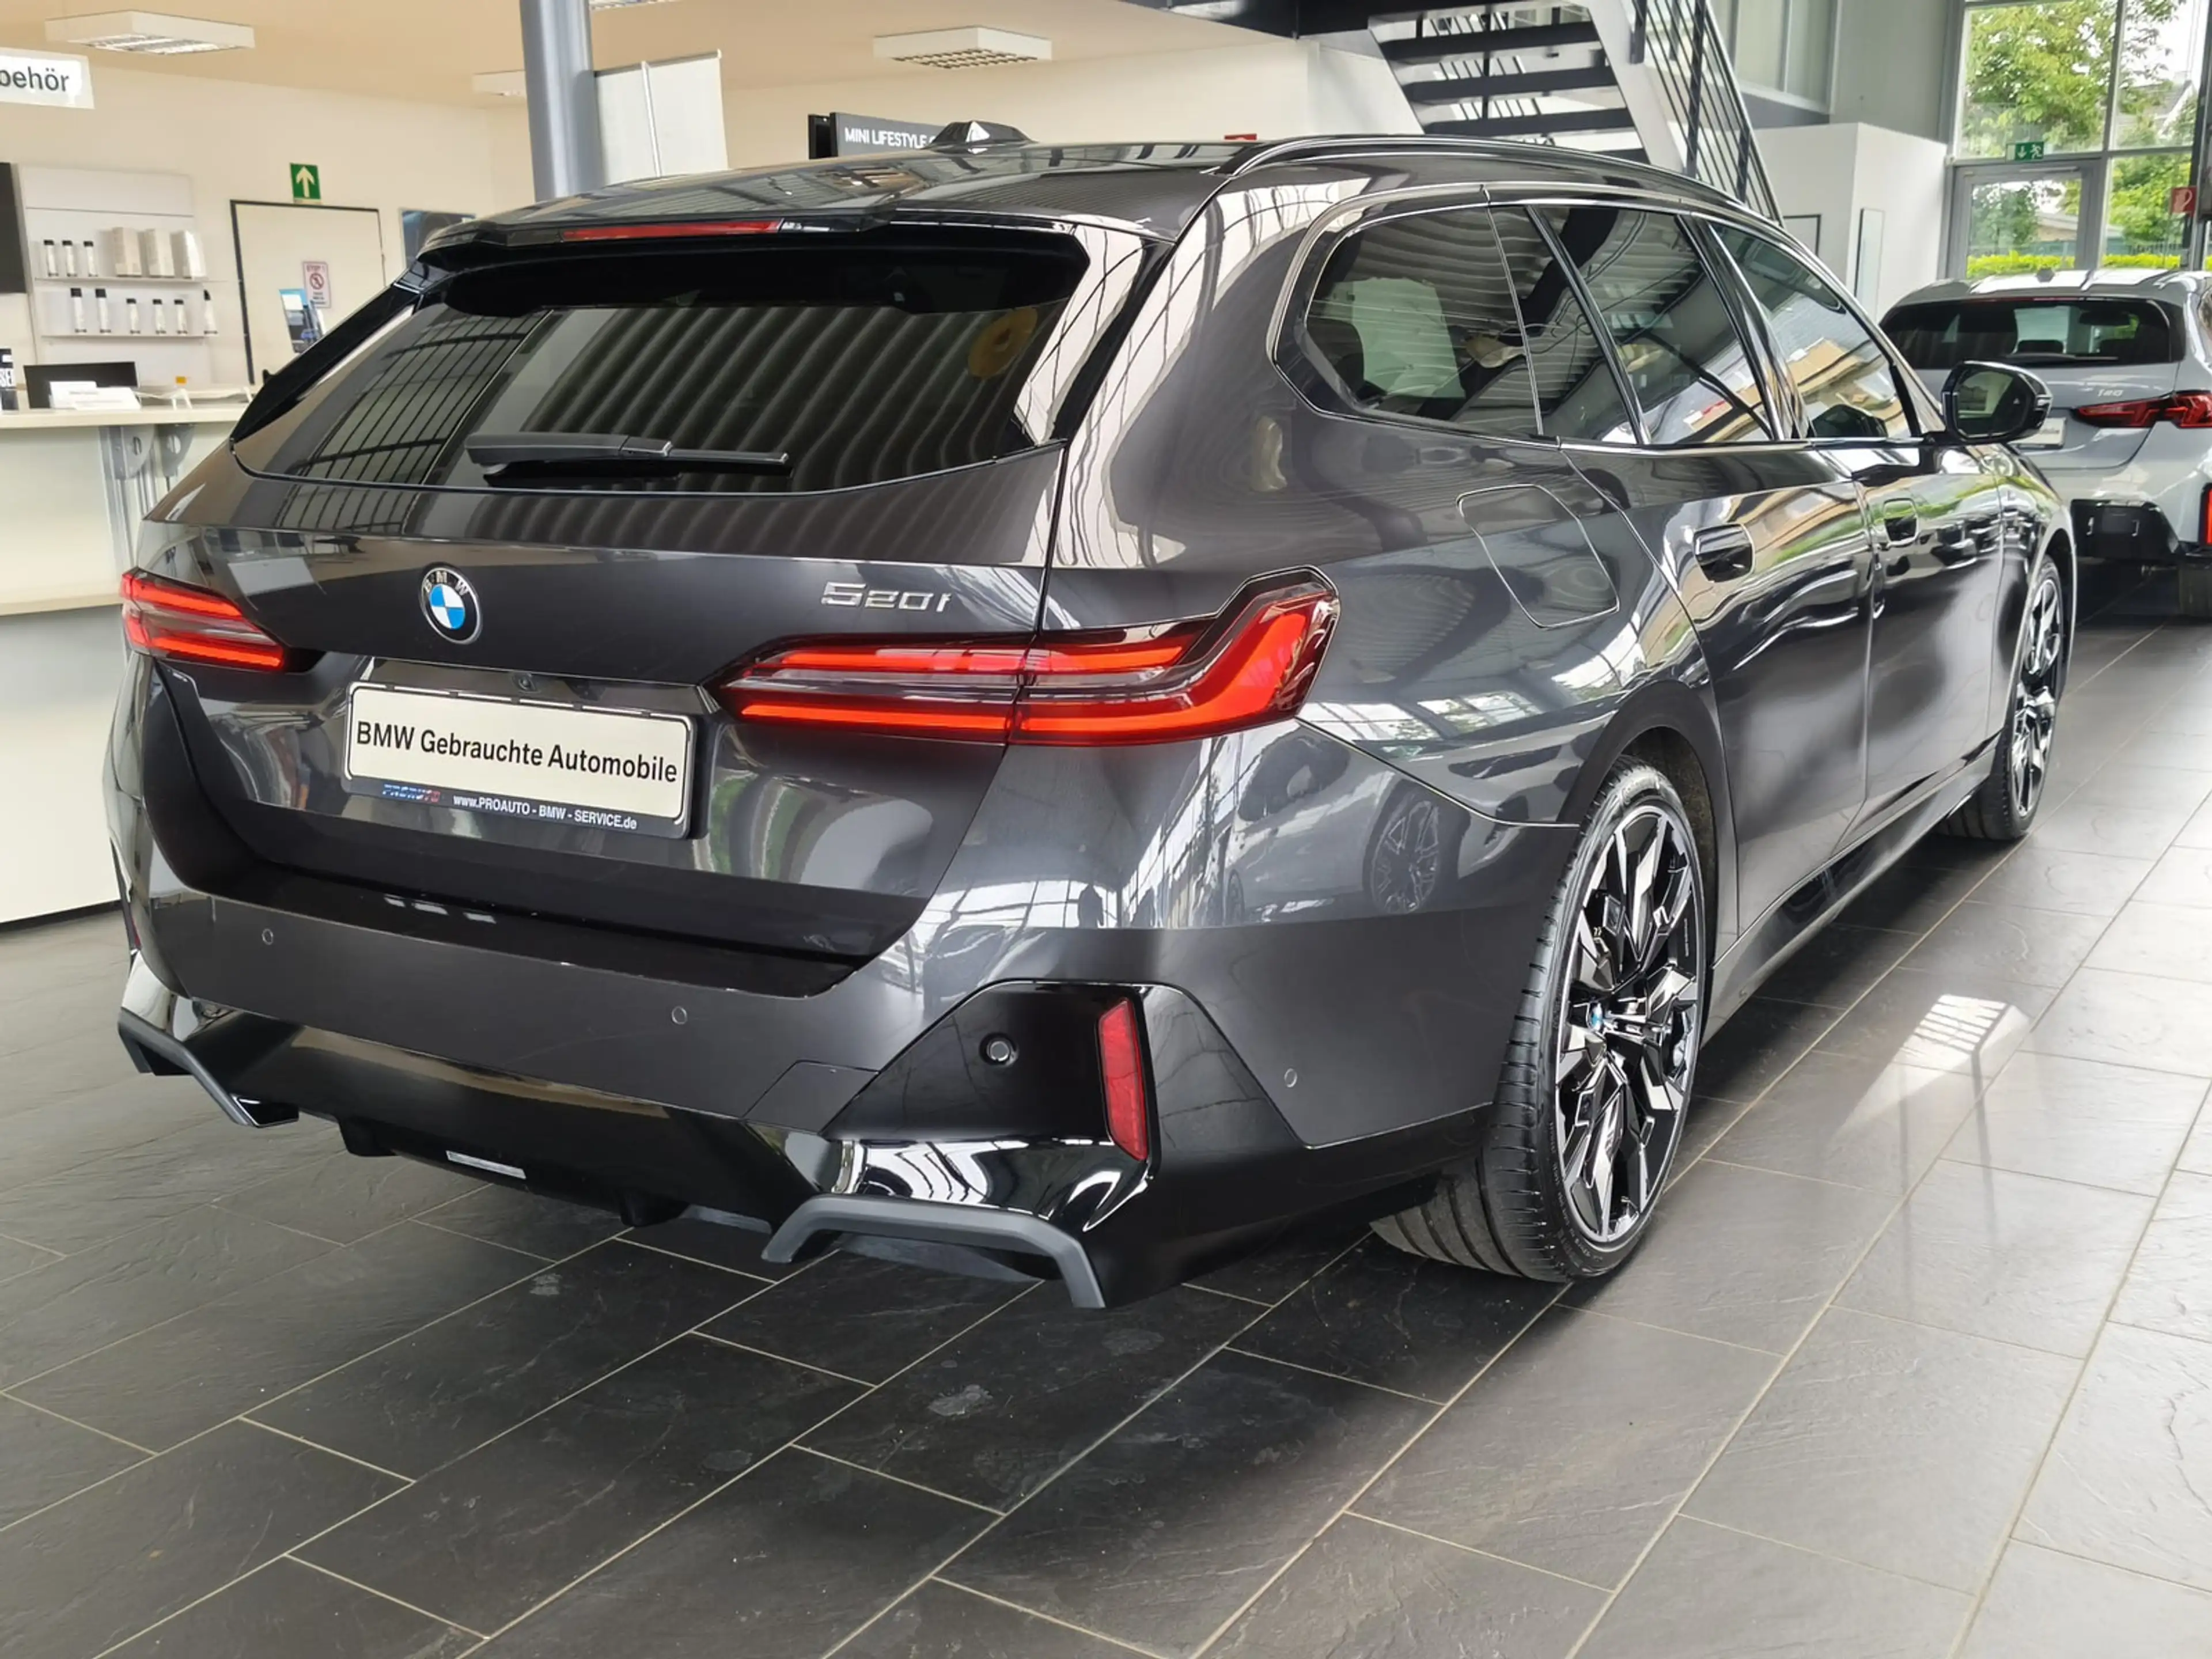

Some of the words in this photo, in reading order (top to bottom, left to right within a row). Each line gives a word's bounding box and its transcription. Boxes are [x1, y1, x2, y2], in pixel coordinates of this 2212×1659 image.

[844, 127, 870, 144] MINI
[872, 129, 927, 149] LIFESTYLE
[423, 570, 471, 596] BMW
[821, 581, 952, 613] 520i
[357, 721, 415, 750] BMW
[421, 729, 543, 766] Gebrauchte
[547, 744, 677, 782] Automobile
[453, 795, 530, 815] www.PROAUTO
[539, 805, 566, 820] BMW
[574, 809, 638, 830] SERVICE.de
